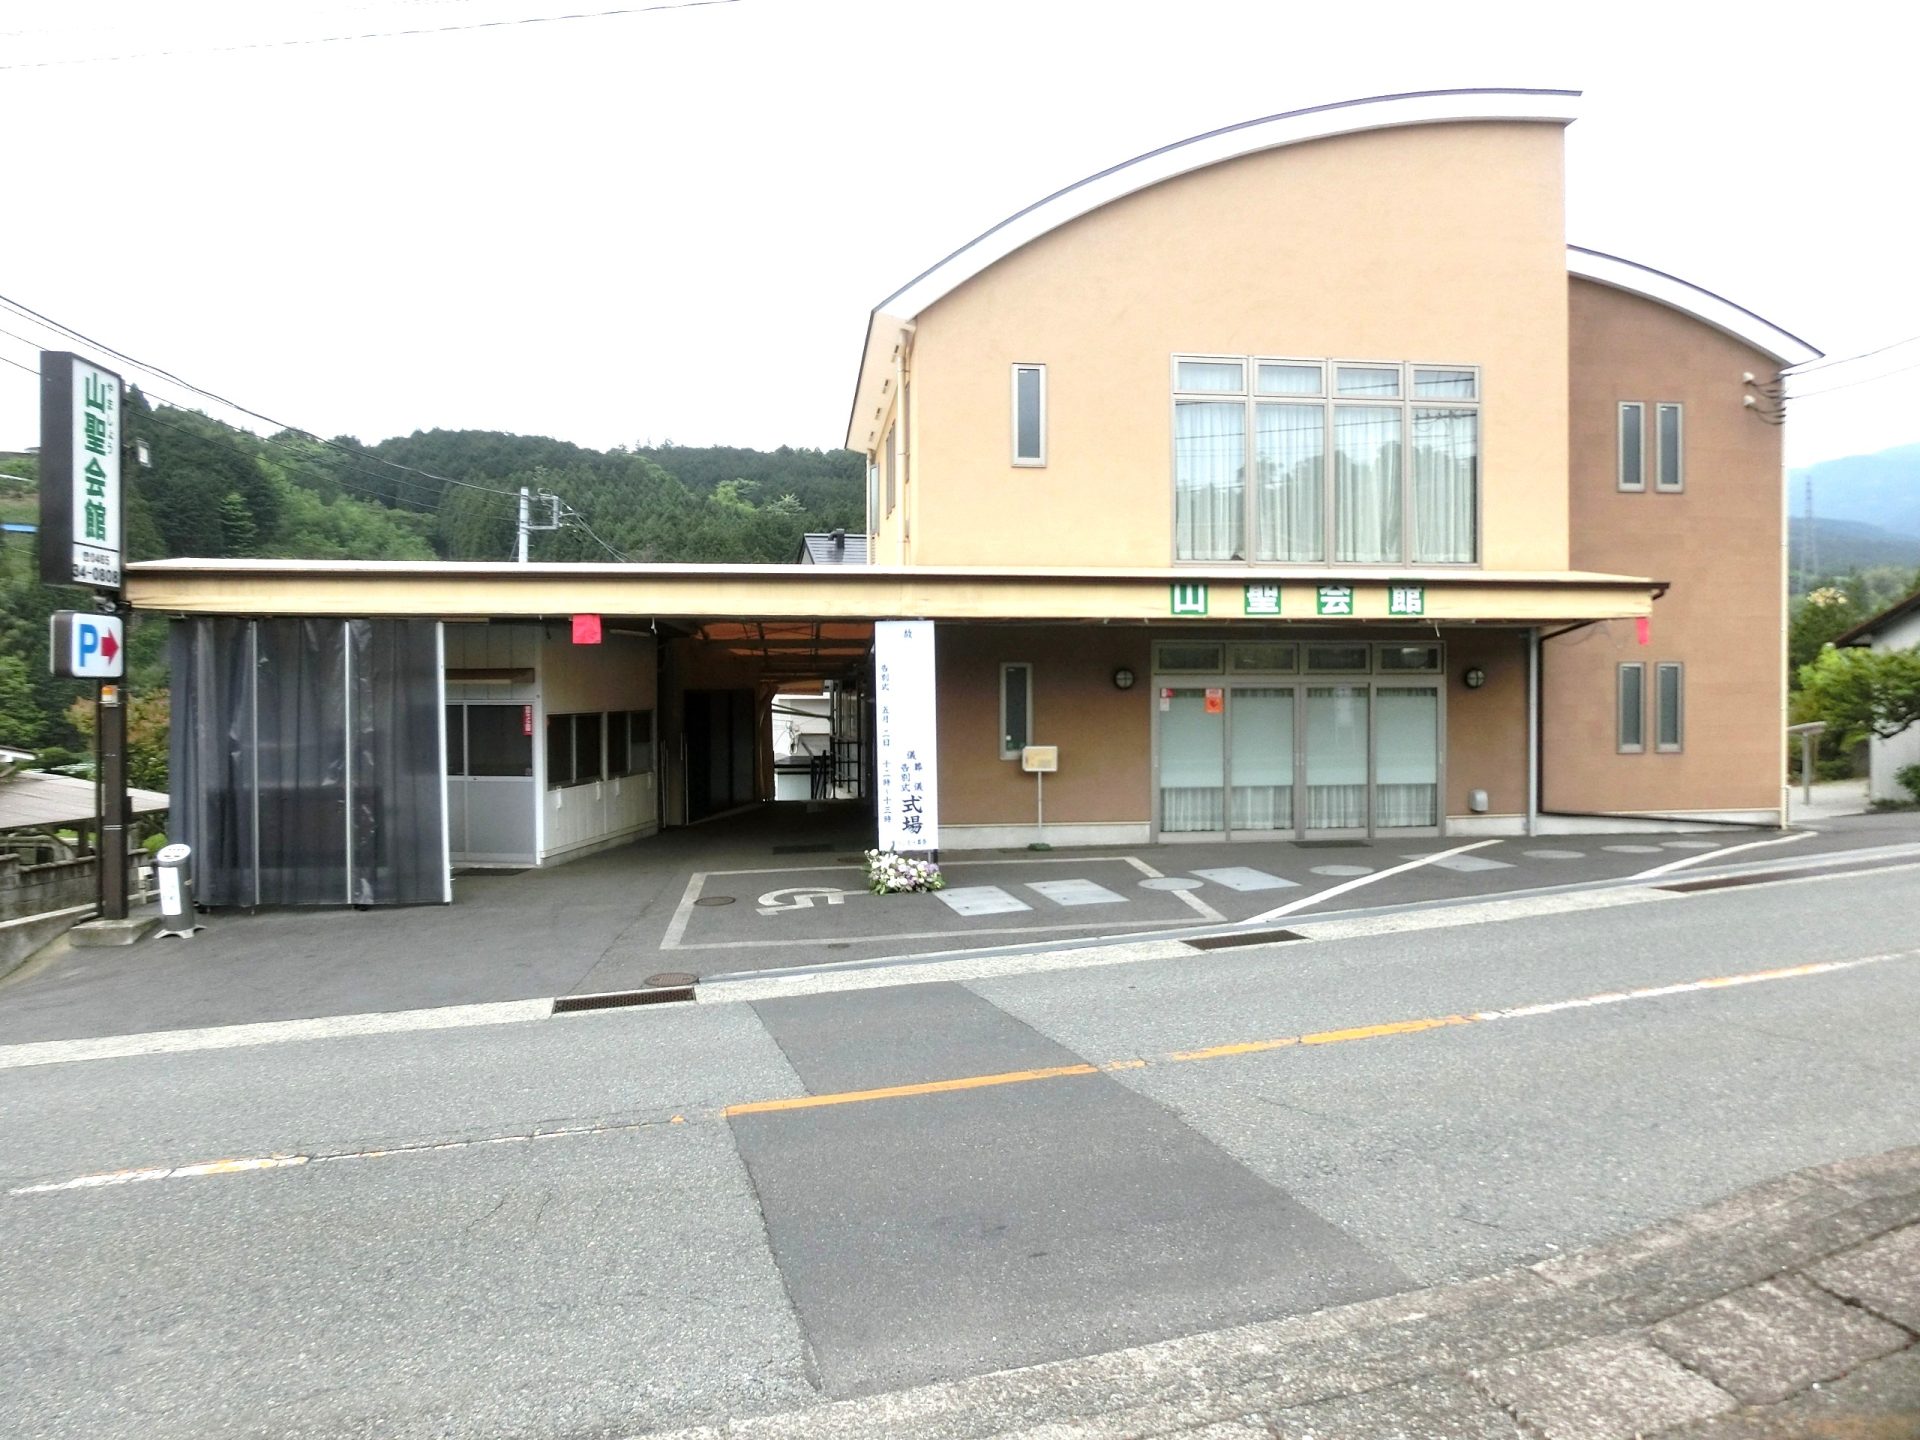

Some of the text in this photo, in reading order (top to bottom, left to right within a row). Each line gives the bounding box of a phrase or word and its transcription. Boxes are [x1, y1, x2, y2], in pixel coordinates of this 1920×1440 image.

[84, 372, 107, 542] 山聖会館
[1173, 584, 1423, 613] 山聖会館
[78, 623, 98, 668] P
[901, 794, 924, 835] 式場
